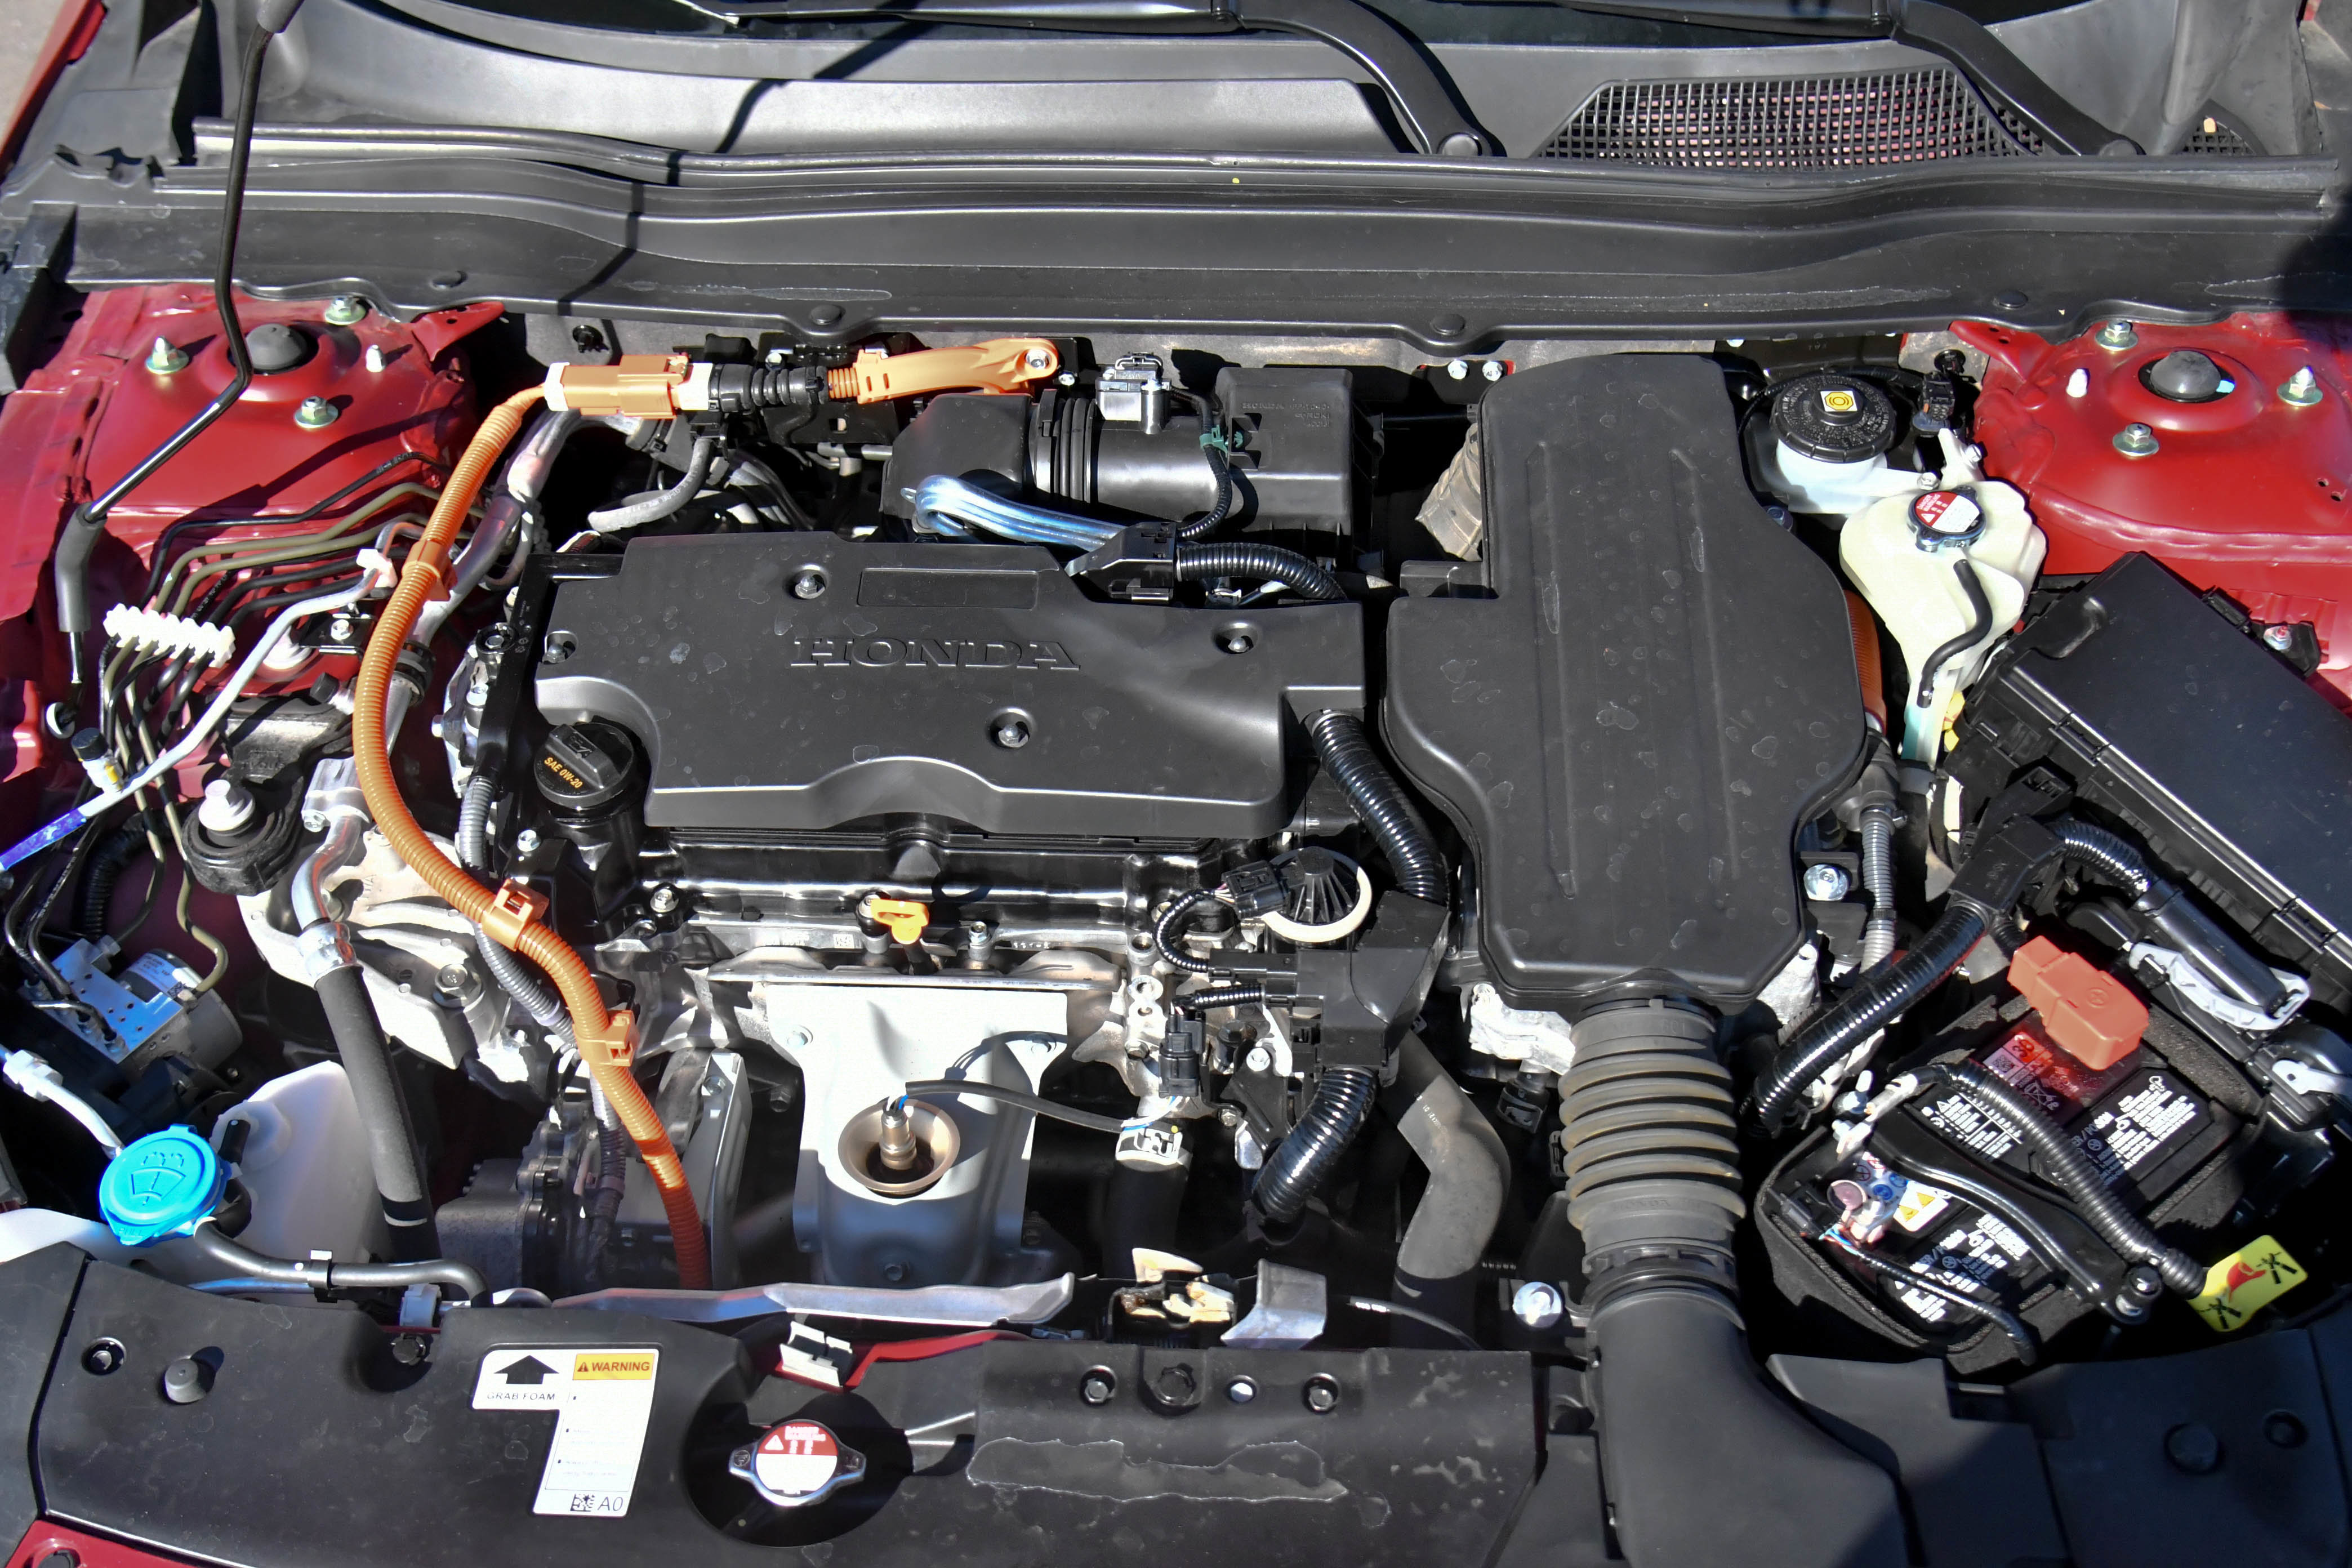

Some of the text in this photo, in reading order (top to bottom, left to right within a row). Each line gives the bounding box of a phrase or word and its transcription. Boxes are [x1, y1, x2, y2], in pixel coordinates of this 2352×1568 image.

[790, 637, 1081, 671] HONDA
[544, 757, 583, 789] SAE 0W-20
[592, 1361, 650, 1371] WARNING
[597, 1496, 623, 1512] A0
